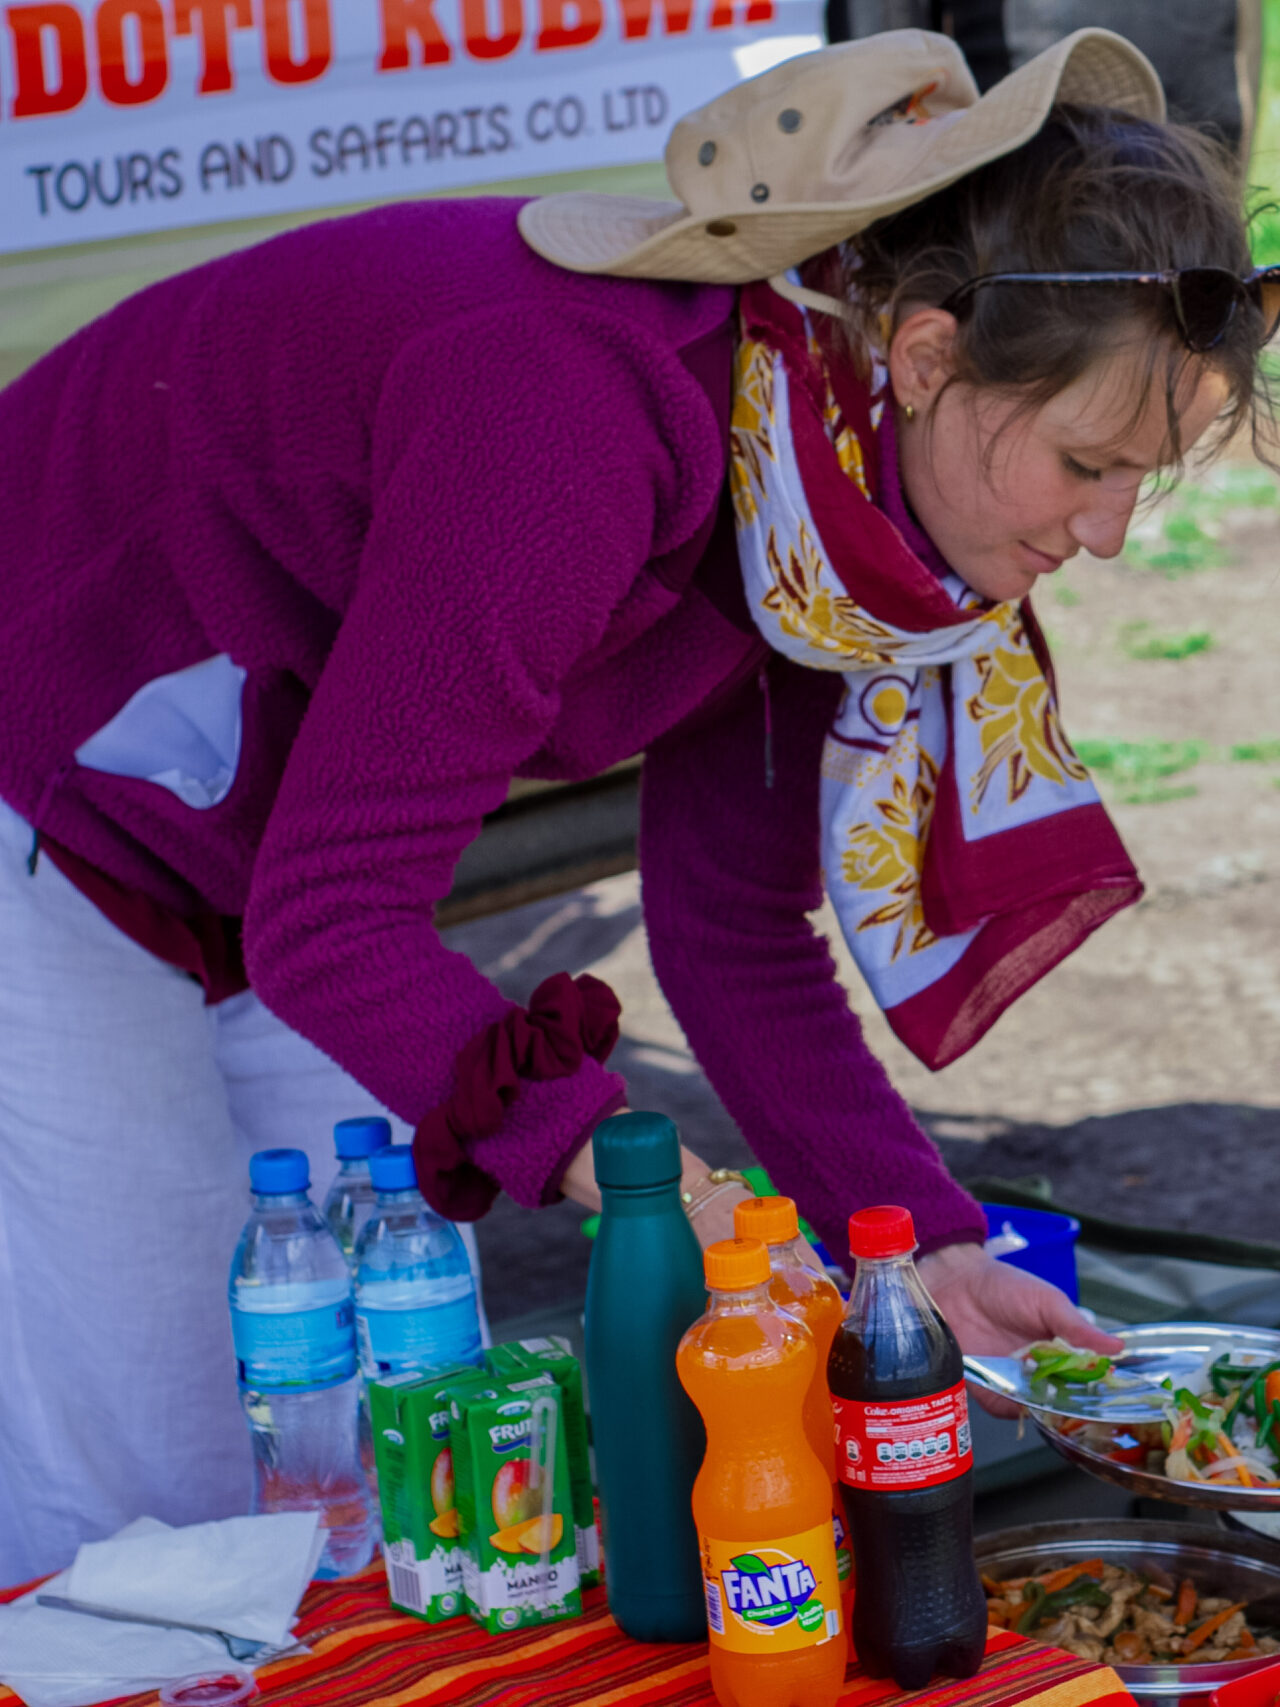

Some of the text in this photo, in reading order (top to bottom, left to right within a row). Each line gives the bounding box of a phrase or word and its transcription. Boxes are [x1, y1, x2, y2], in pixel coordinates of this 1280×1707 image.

[26, 149, 183, 216] TOURS
[200, 135, 296, 192] AND
[604, 83, 669, 132] LTD
[722, 1561, 816, 1609] FANTA
